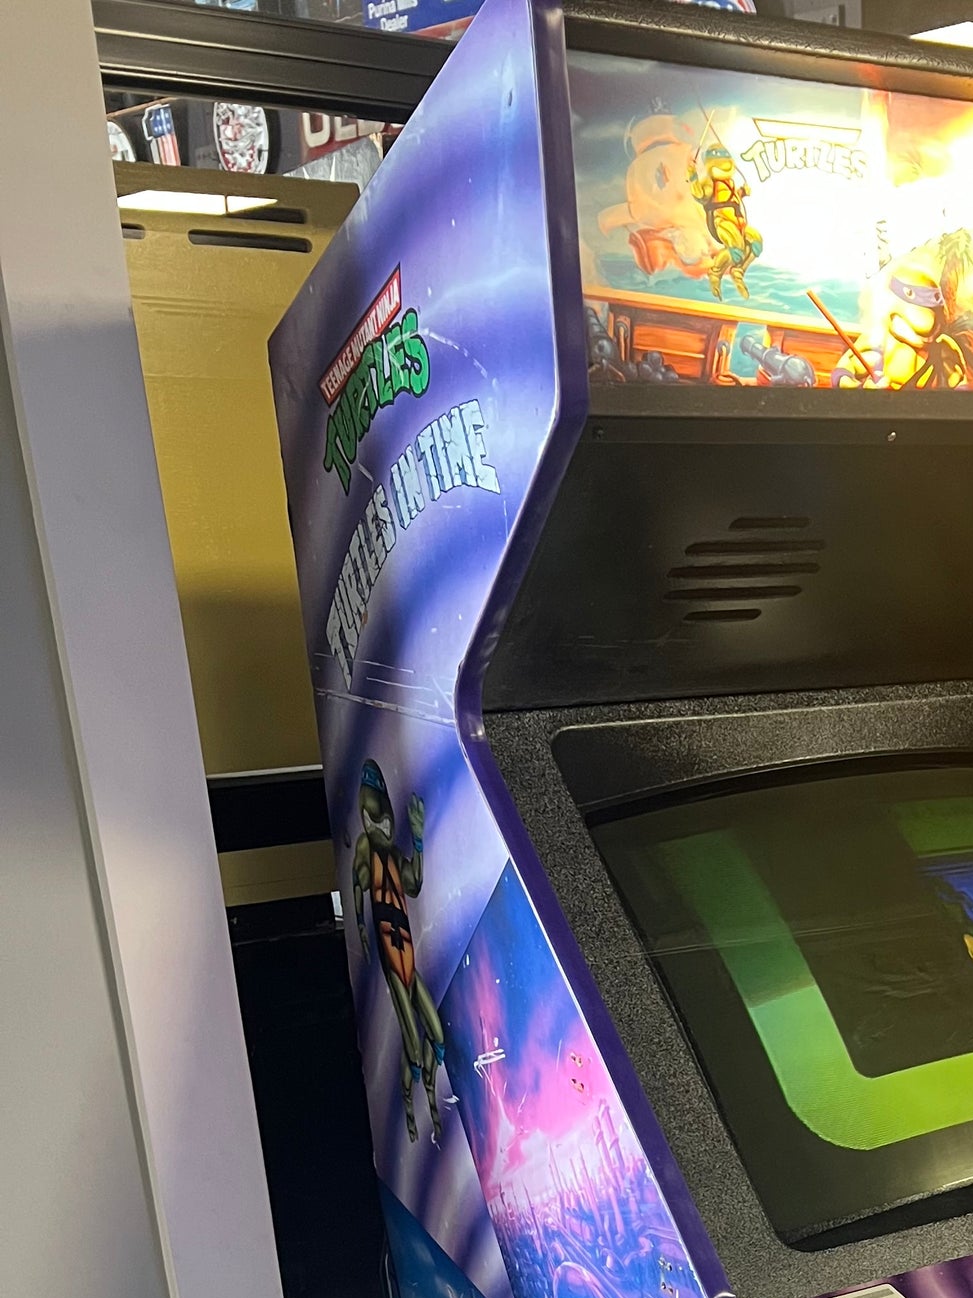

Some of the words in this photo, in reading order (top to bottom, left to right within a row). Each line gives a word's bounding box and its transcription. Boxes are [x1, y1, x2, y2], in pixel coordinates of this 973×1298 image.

[319, 355, 352, 399] TEENAGE
[352, 315, 380, 362] MUTANT
[378, 277, 400, 326] NINJA
[323, 307, 430, 496] TURTLES
[325, 484, 396, 690] TURTLES
[390, 444, 425, 531] IN
[415, 398, 501, 502] TIME
